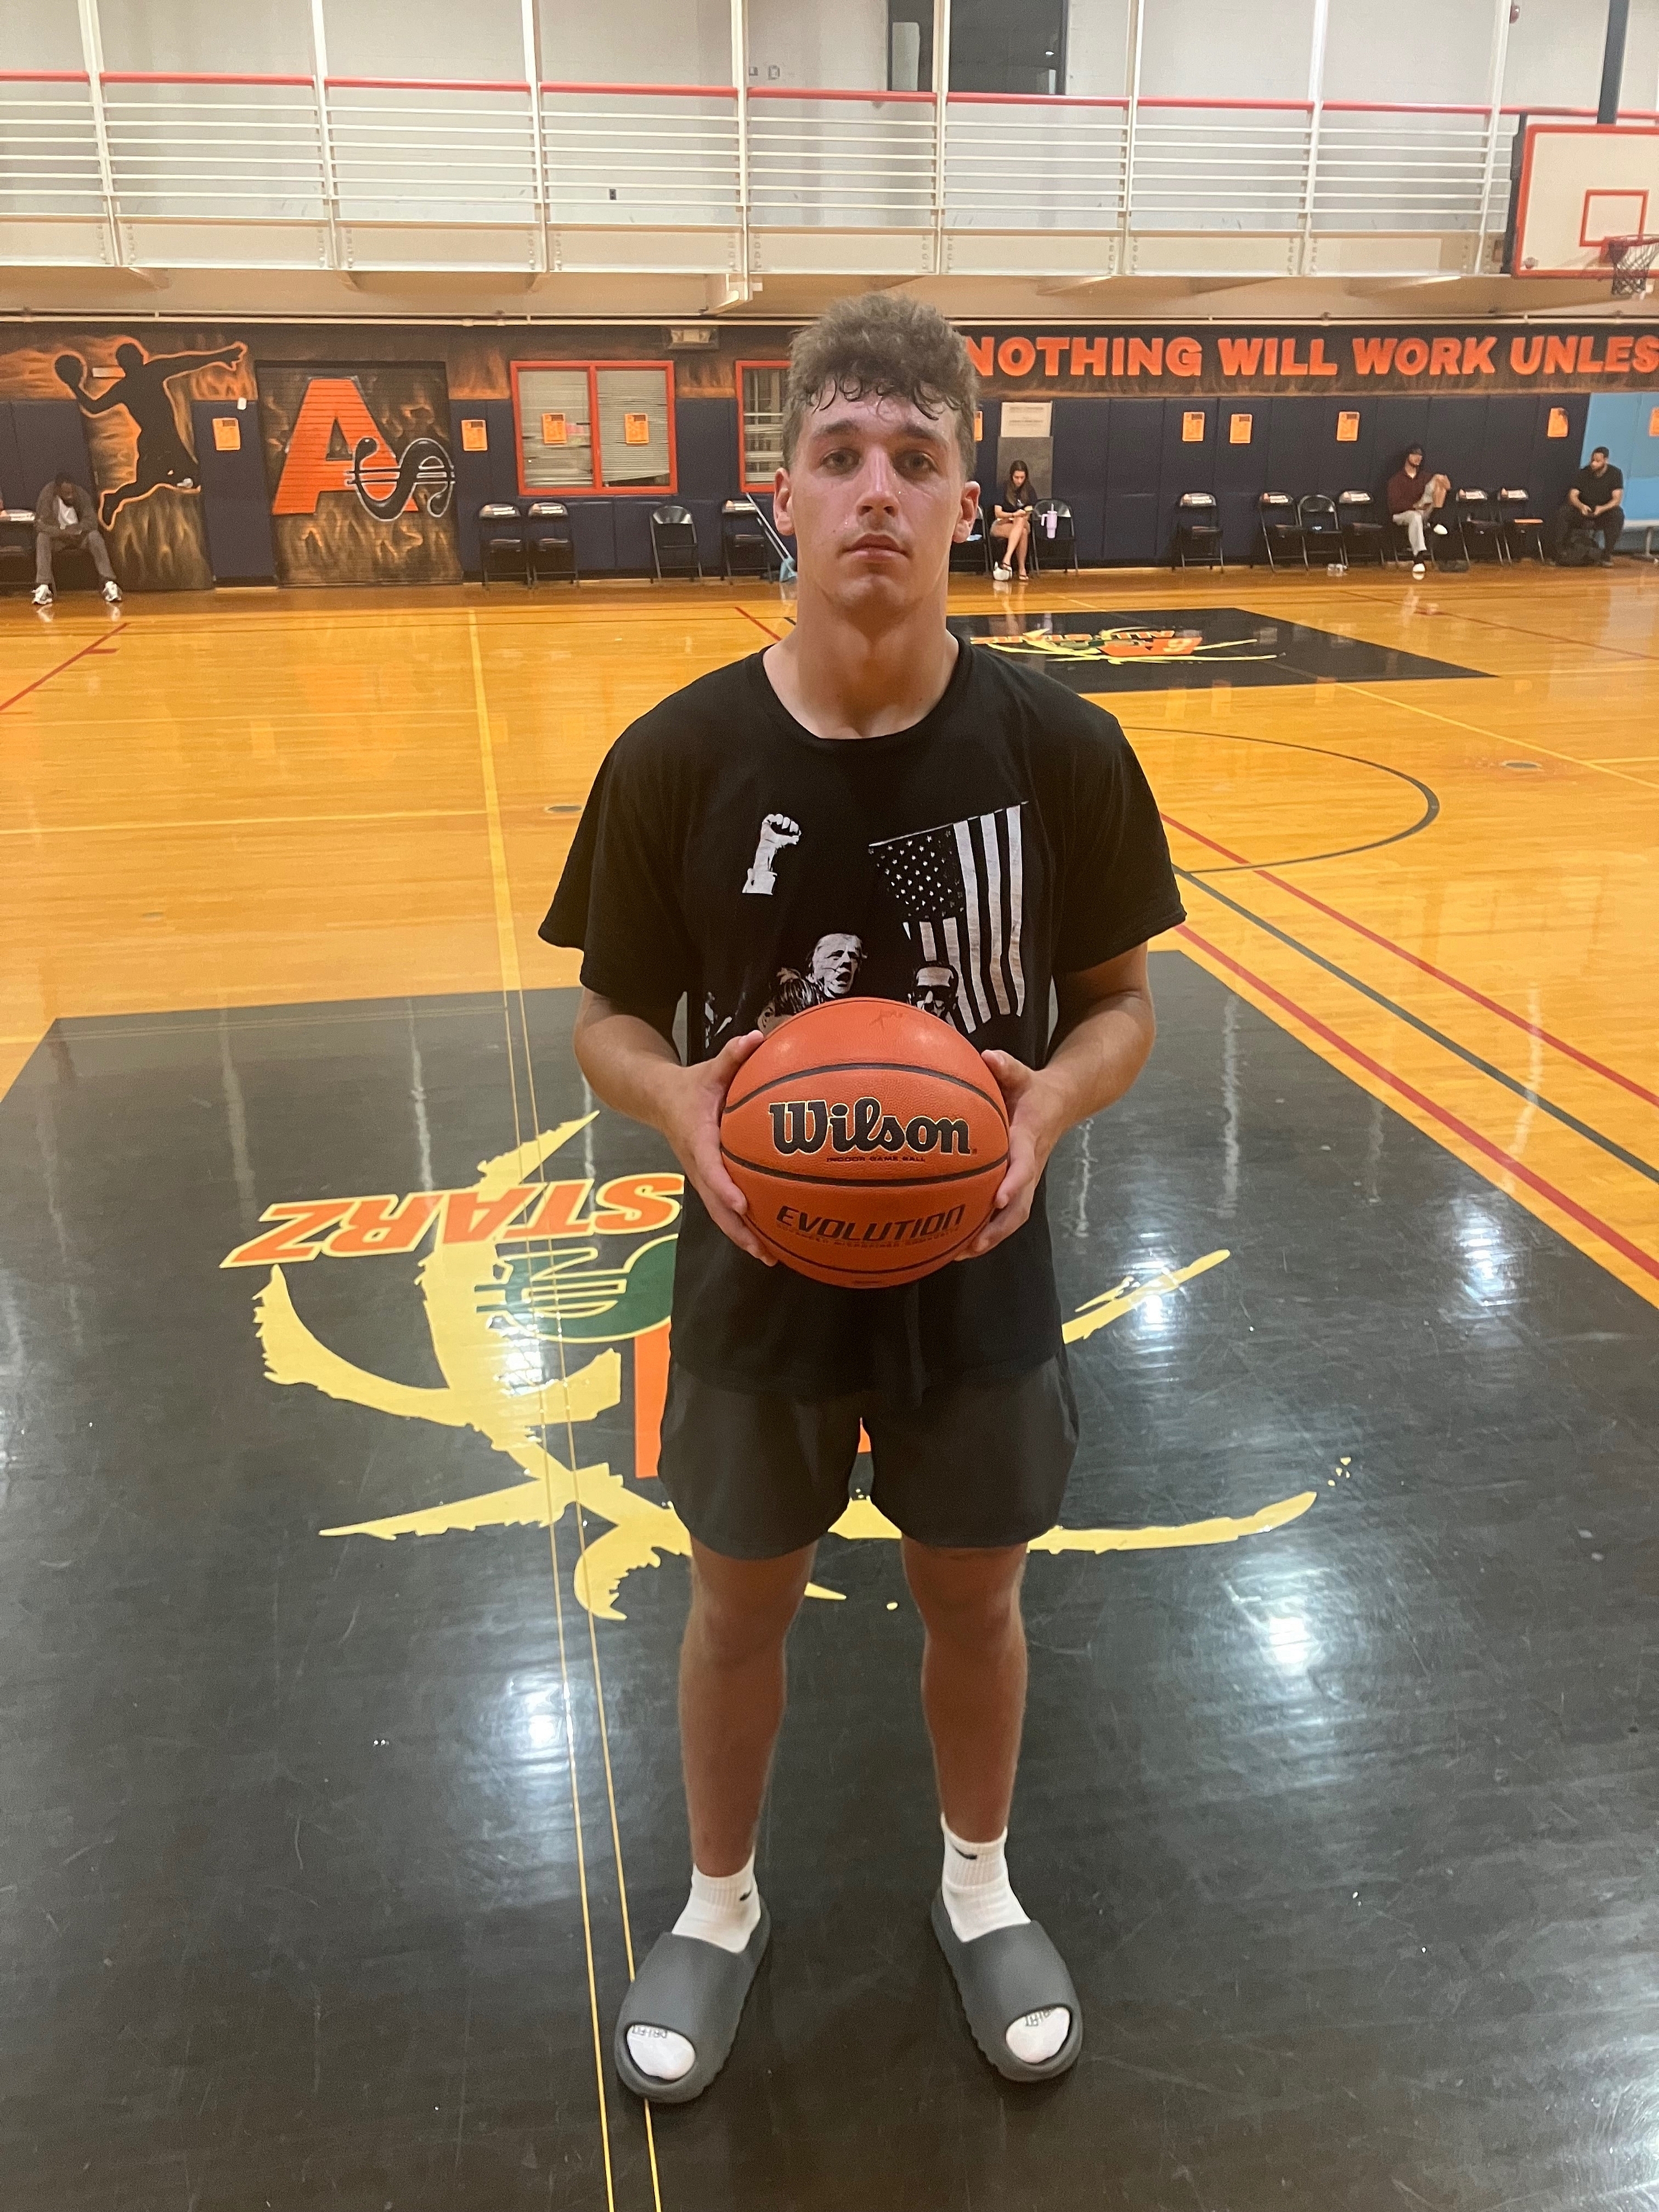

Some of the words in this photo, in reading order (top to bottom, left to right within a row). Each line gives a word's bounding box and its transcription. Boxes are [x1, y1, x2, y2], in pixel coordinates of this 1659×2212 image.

[966, 336, 1203, 376] NOTHING
[1217, 337, 1338, 376] WILL
[1352, 336, 1498, 375] WORK
[1510, 335, 1659, 375] UNLES
[768, 1097, 972, 1155] Wilson
[219, 1173, 685, 1269] STARZ
[776, 1203, 966, 1242] EVOLUTION
